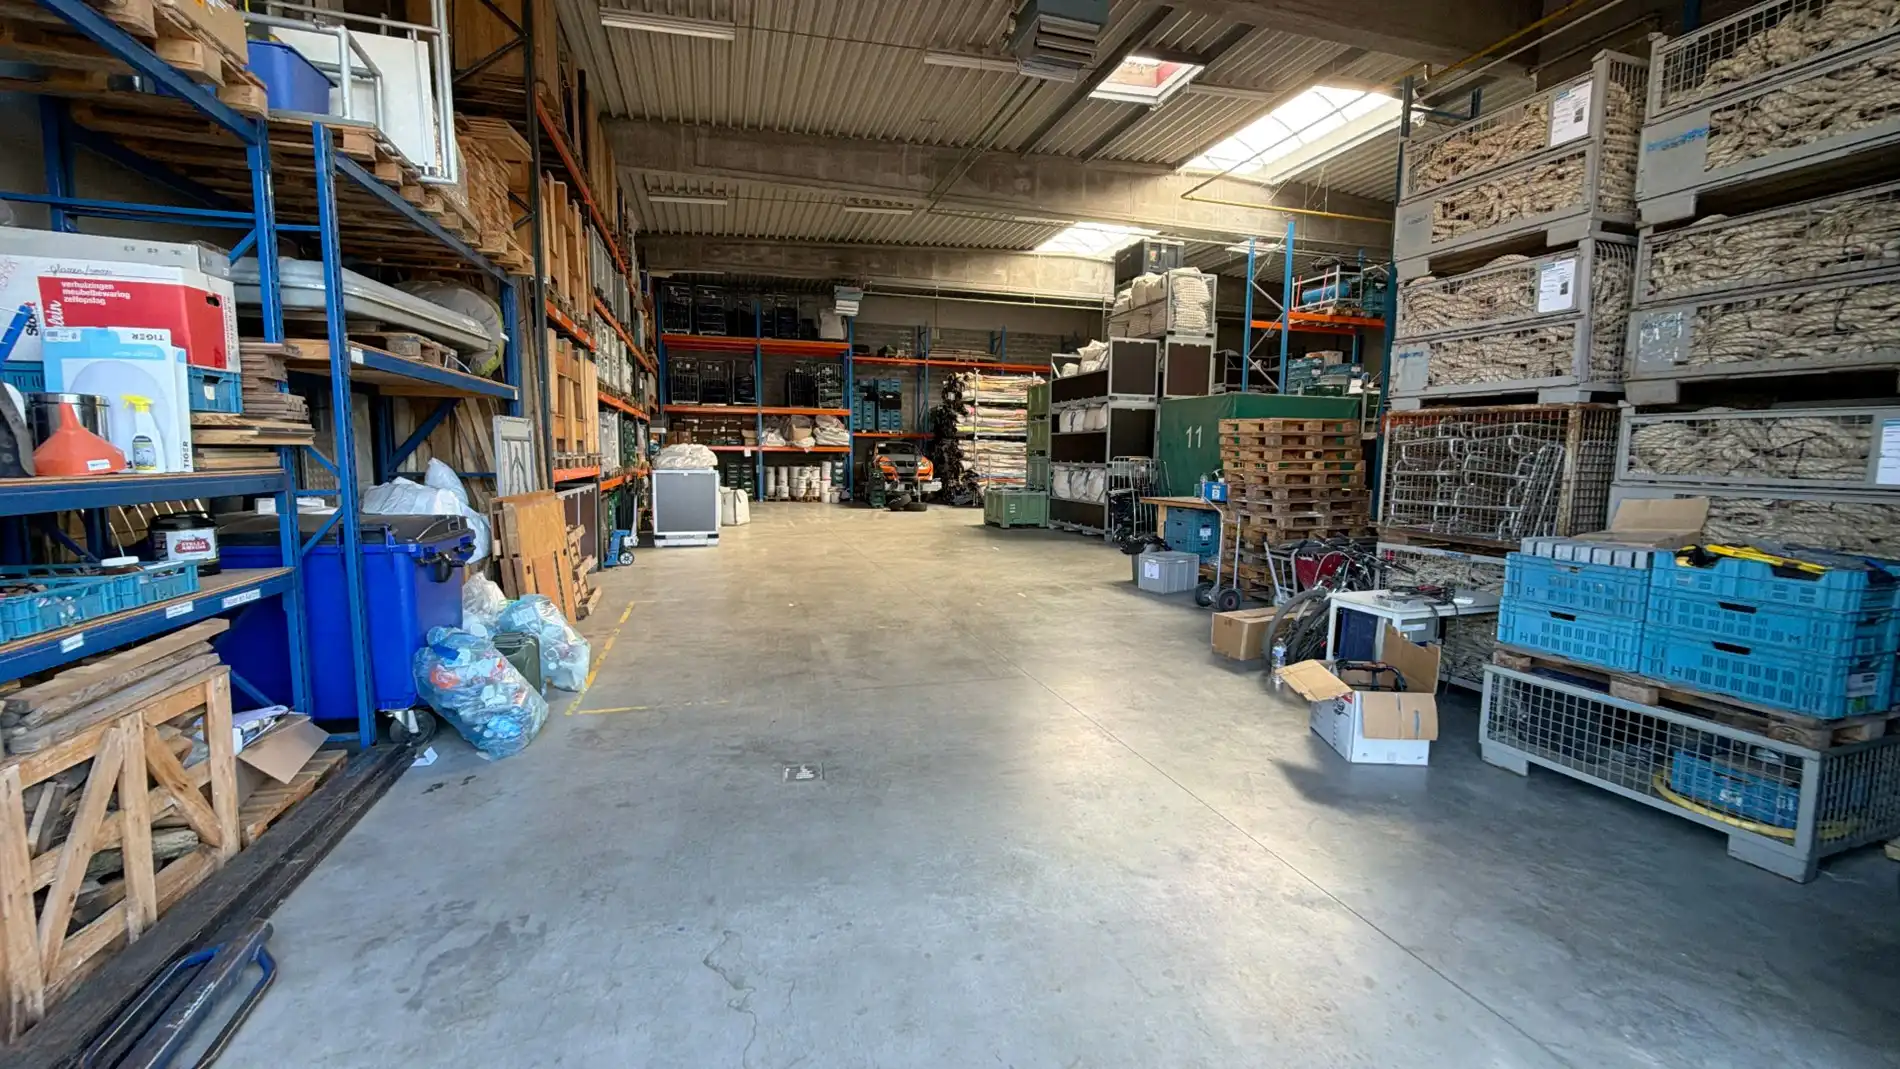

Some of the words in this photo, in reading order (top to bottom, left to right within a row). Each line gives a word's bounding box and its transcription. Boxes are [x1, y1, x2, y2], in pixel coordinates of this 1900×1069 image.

[61, 281, 114, 290] verhuizingen
[63, 289, 131, 299] meubelbewaring
[131, 333, 164, 341] TIGER
[1186, 425, 1202, 449] 11
